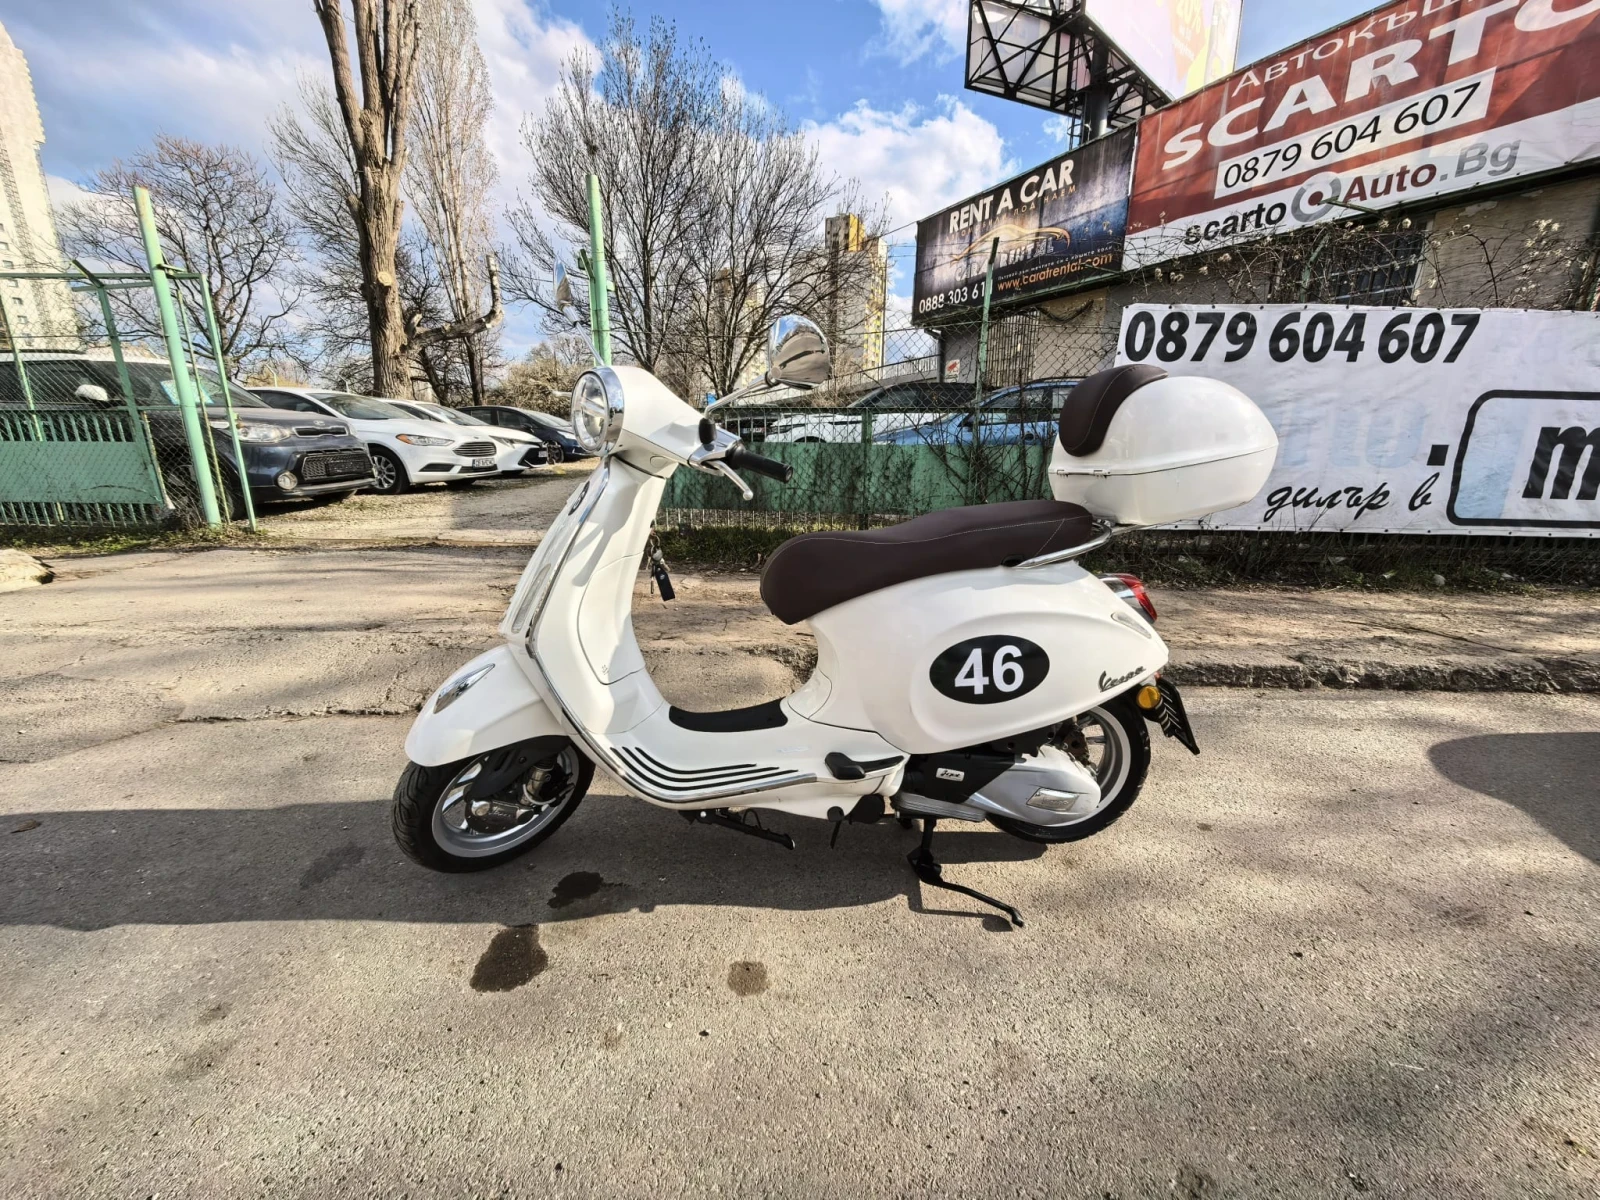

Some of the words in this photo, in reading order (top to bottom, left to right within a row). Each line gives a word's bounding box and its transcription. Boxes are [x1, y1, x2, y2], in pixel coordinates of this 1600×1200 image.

[1223, 143, 1302, 189] 0879
[1311, 115, 1382, 161] 604
[1393, 82, 1482, 134] 607
[950, 194, 994, 233] RENT
[997, 187, 1013, 215] A
[1020, 159, 1074, 203] CAR
[919, 293, 945, 313] 0888
[948, 286, 968, 304] 303
[1125, 311, 1257, 363] 0879
[1269, 312, 1365, 363] 604
[1378, 312, 1481, 364] 607
[954, 645, 1024, 695] 46
